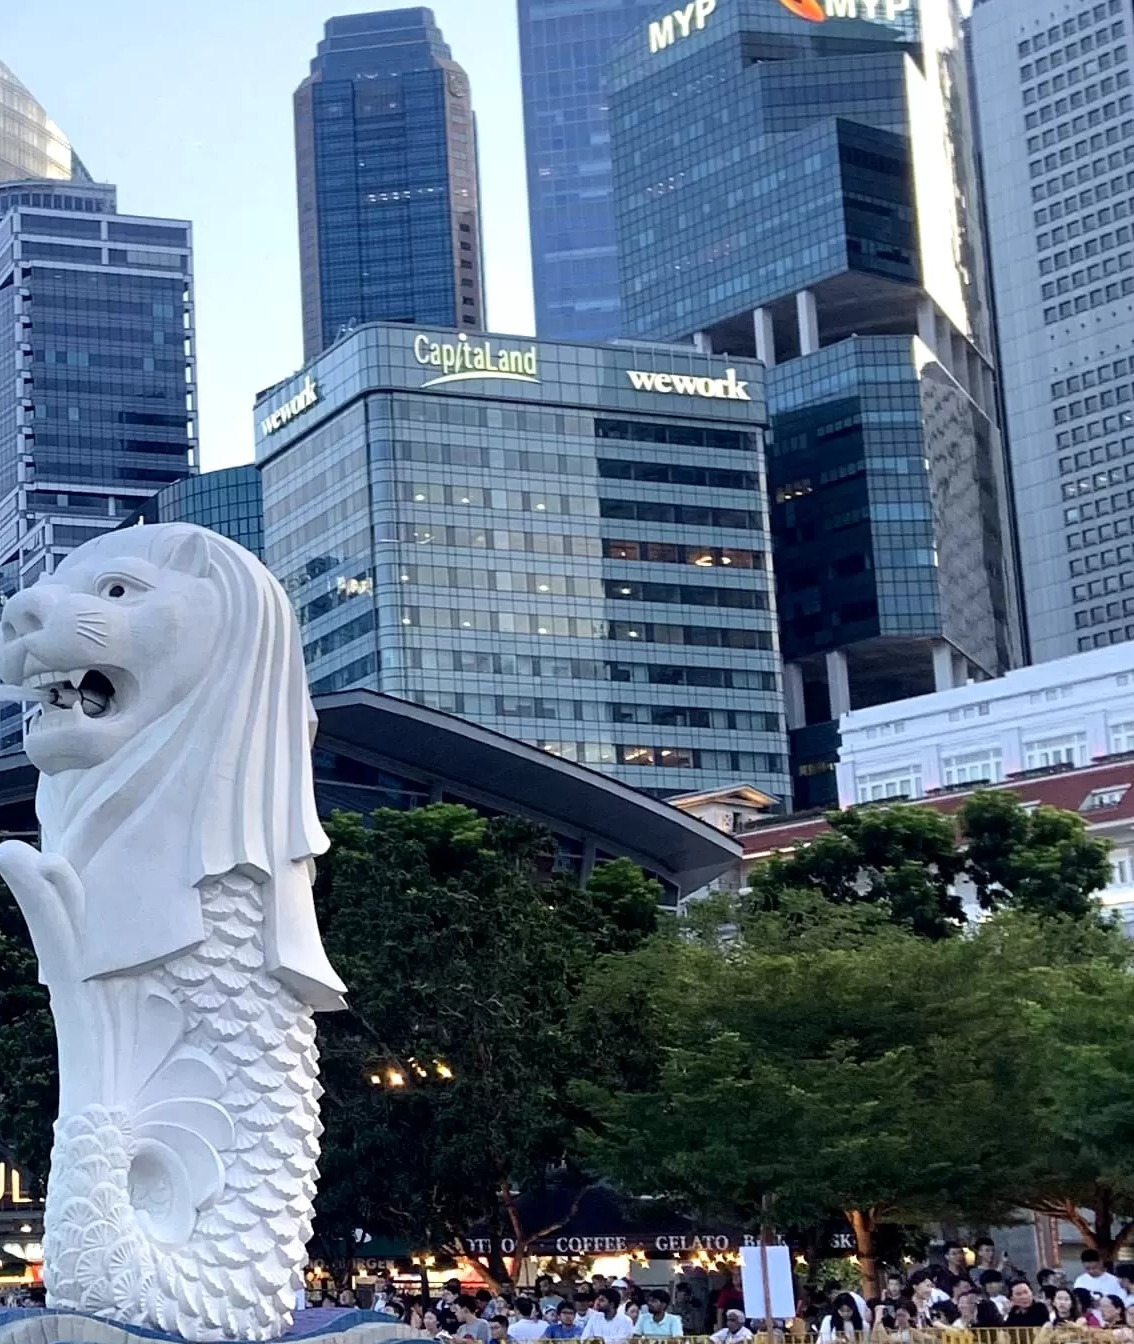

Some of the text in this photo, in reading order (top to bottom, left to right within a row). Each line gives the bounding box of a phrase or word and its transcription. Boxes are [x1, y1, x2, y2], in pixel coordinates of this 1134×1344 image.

[415, 332, 537, 375] CapitaLand
[626, 368, 751, 401] wework
[261, 375, 318, 437] wework
[556, 1235, 627, 1253] COFFEE
[655, 1234, 729, 1251] GELATO
